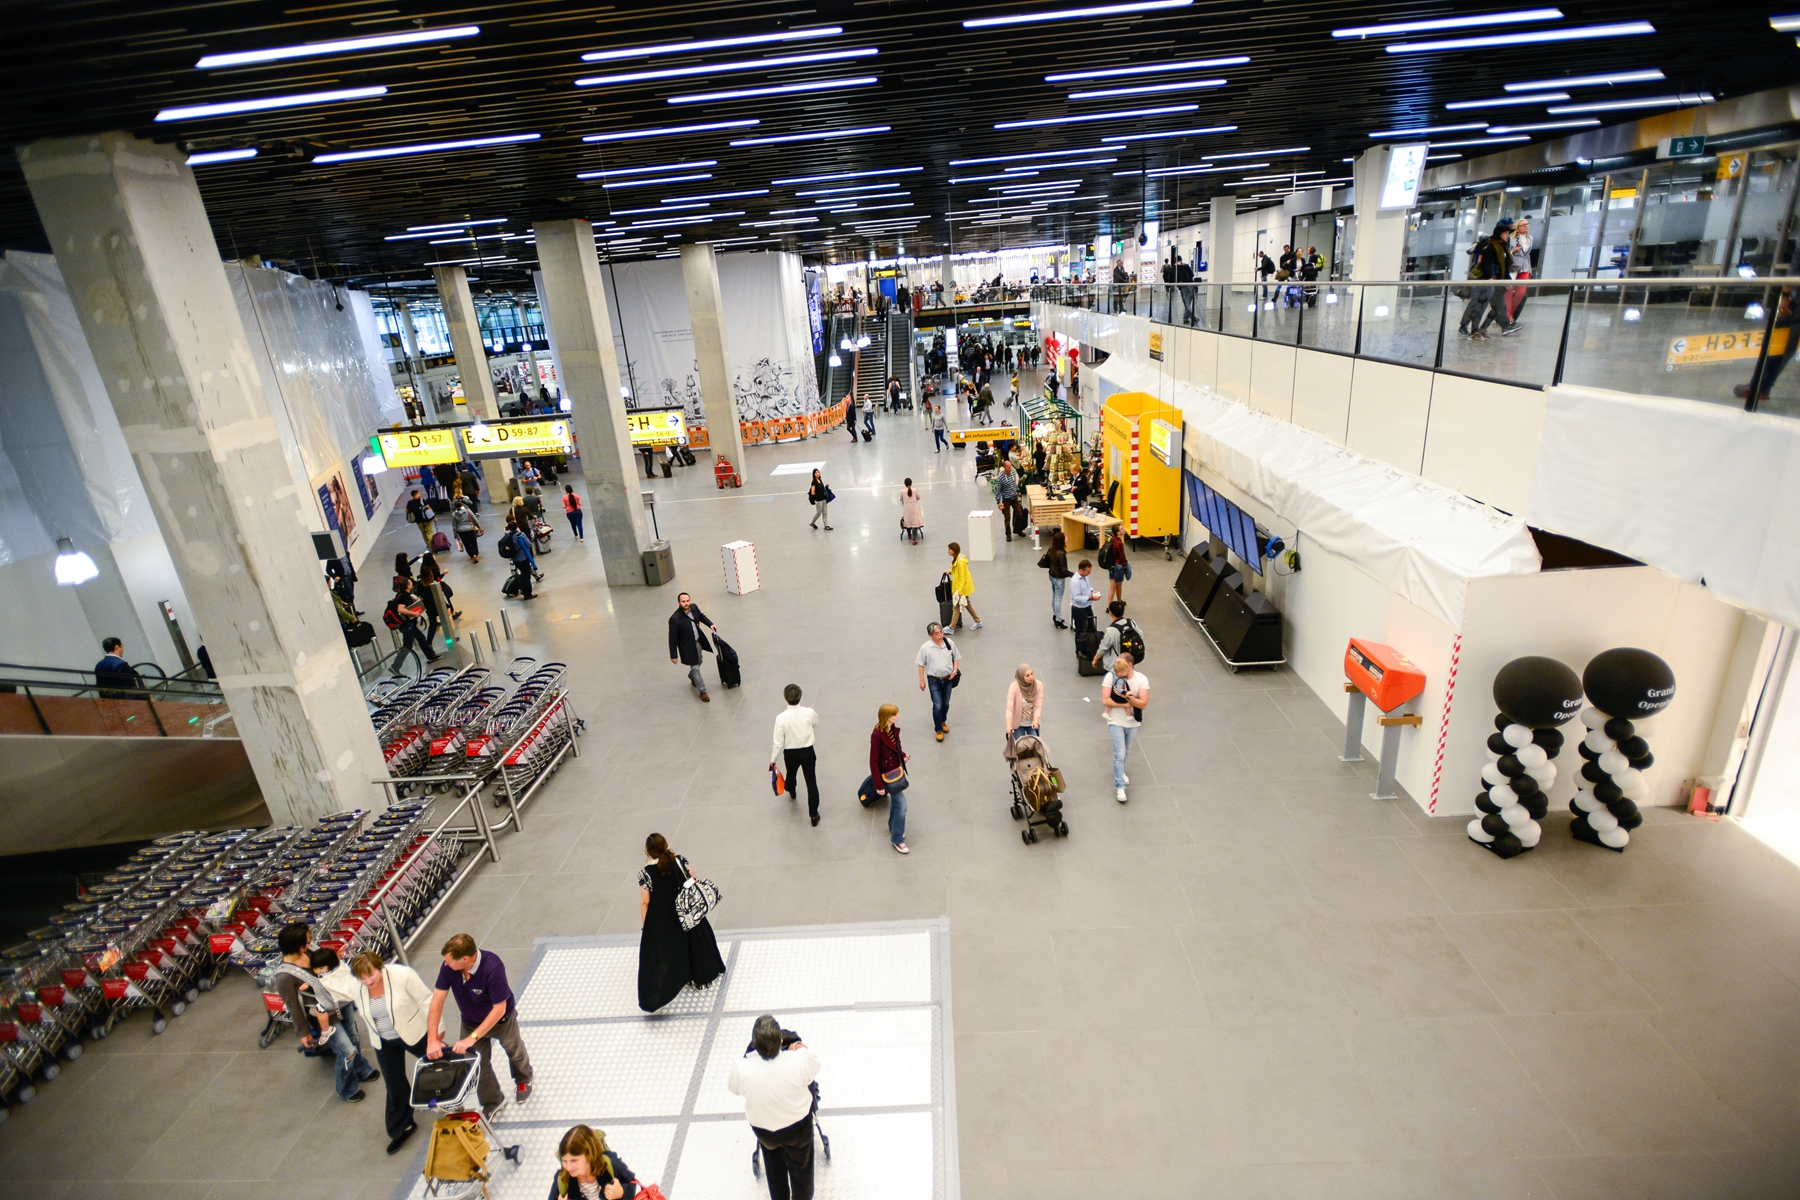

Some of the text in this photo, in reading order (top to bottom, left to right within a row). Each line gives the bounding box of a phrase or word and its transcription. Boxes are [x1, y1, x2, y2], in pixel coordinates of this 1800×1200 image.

[638, 416, 650, 430] H
[409, 435, 421, 448] D
[423, 434, 442, 444] 1-57
[497, 428, 509, 442] D
[511, 427, 539, 438] 59-87
[1647, 684, 1675, 698] Grand
